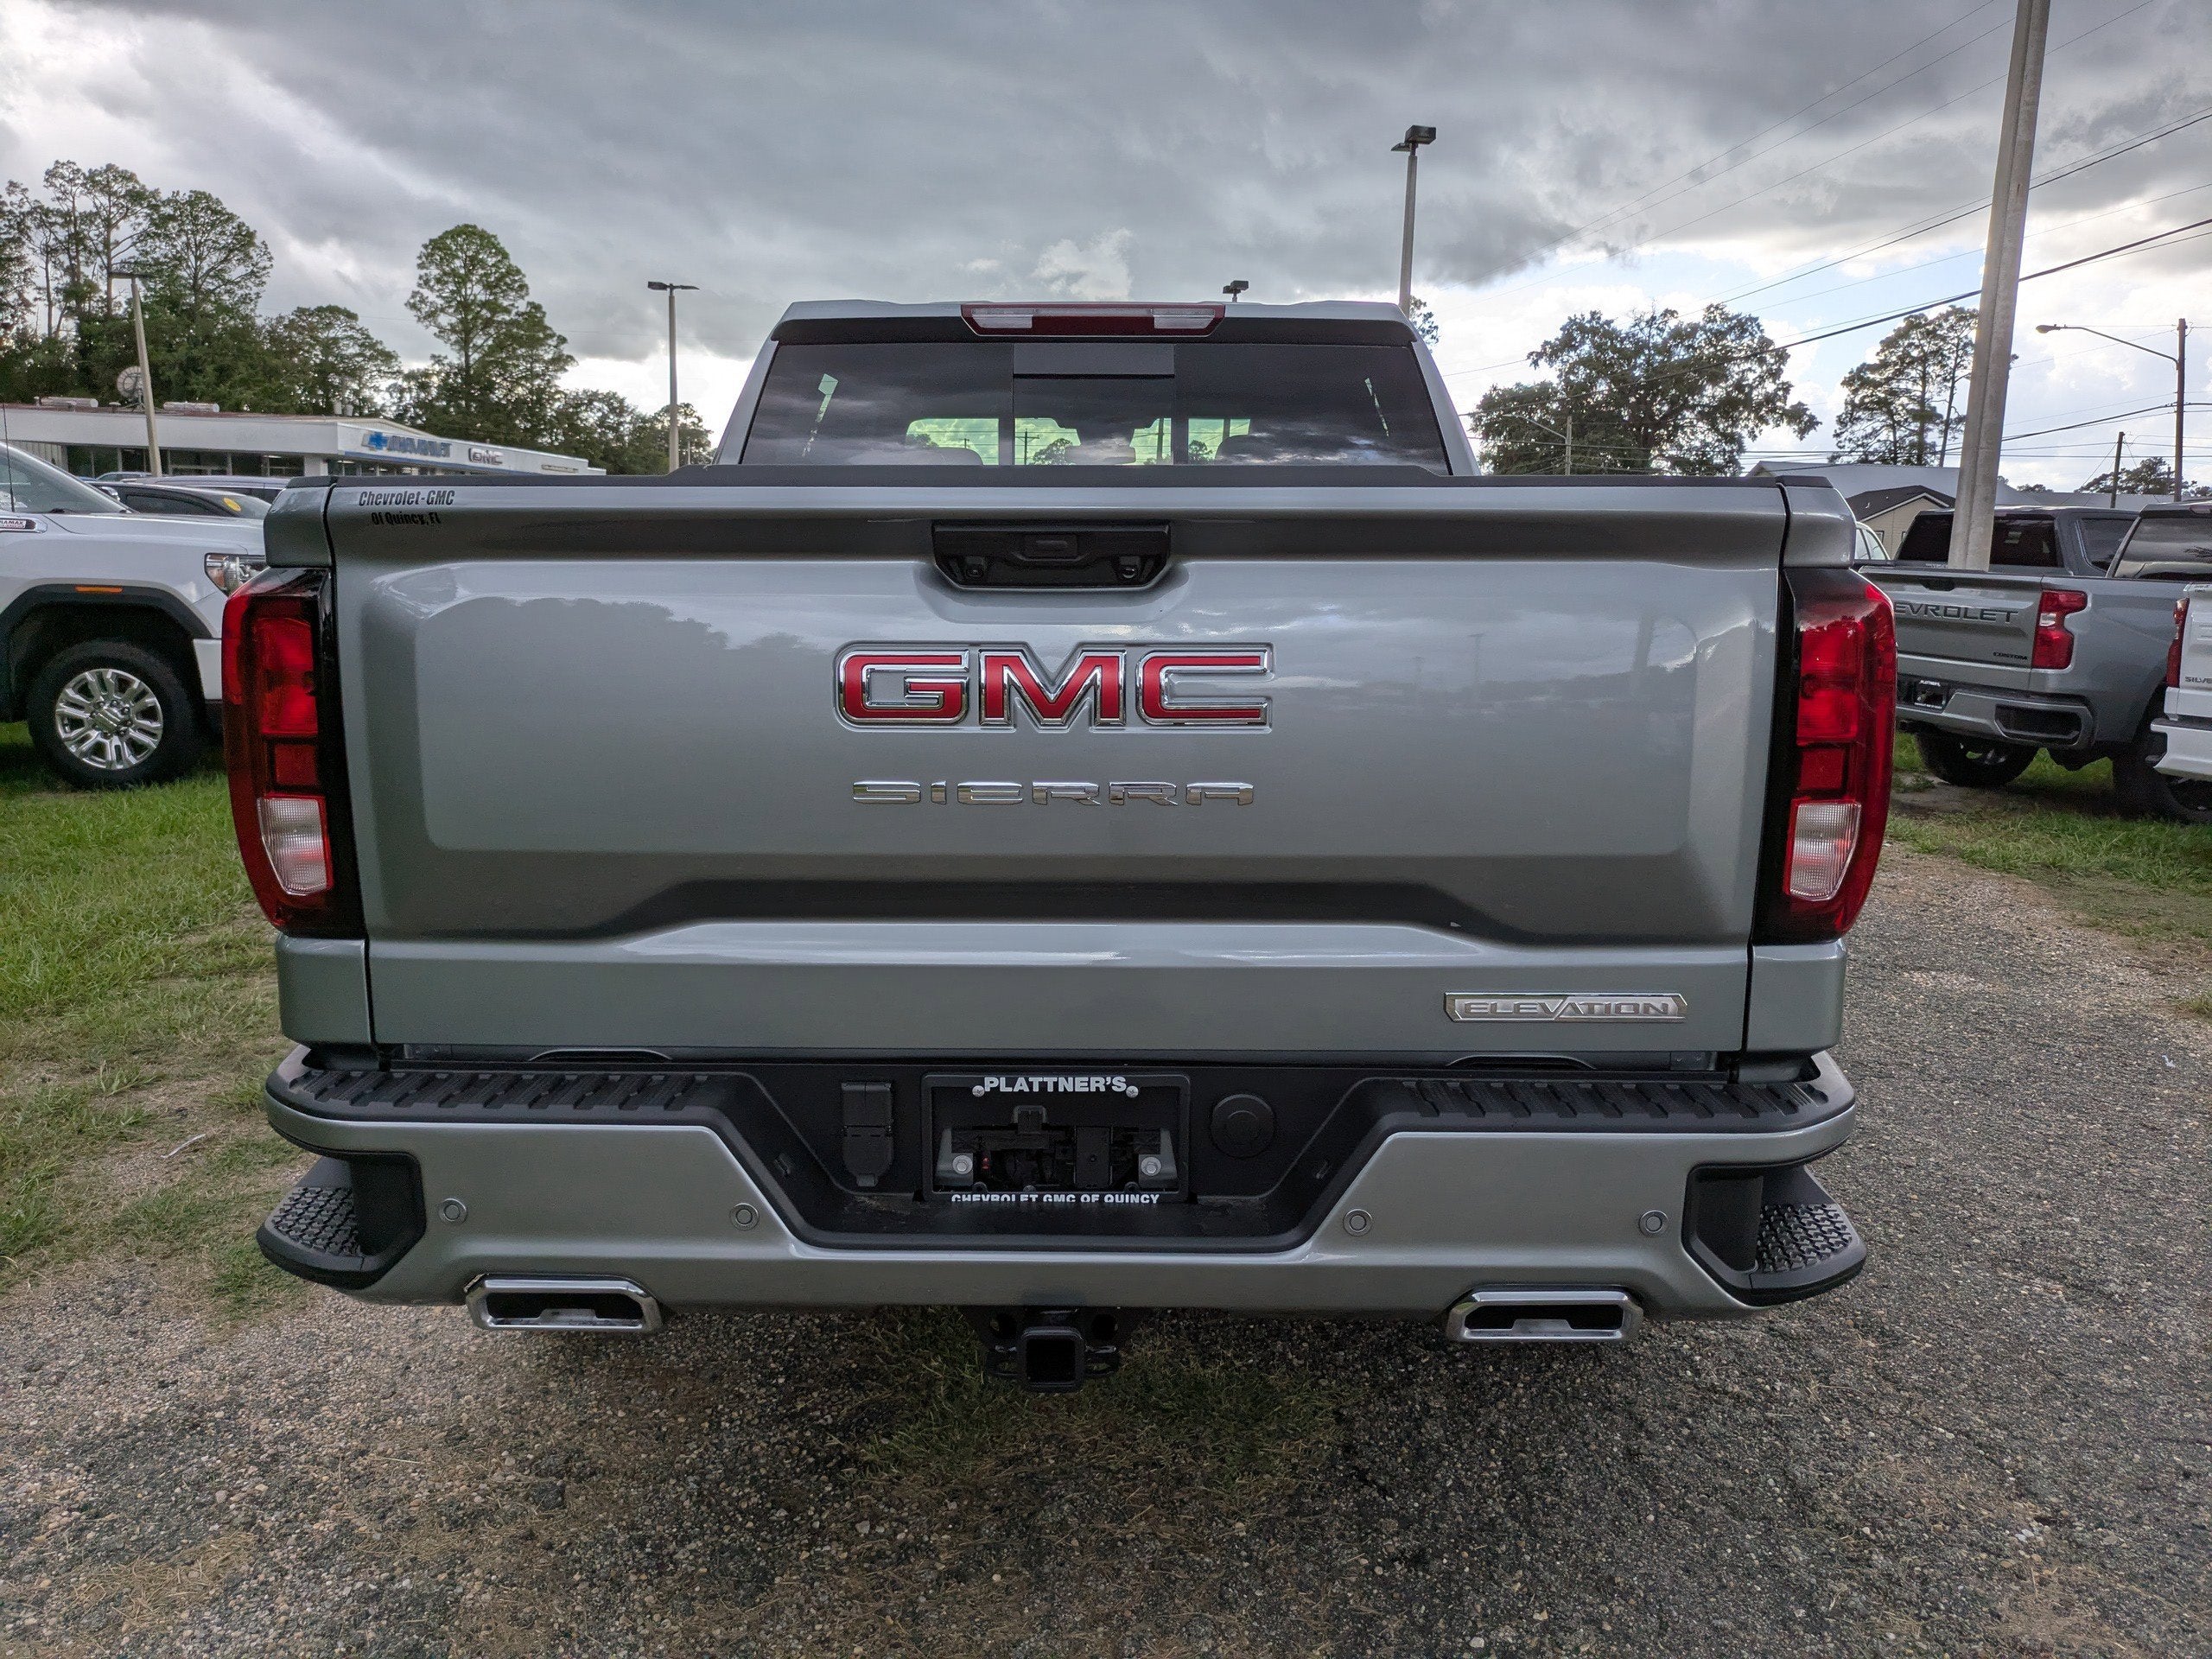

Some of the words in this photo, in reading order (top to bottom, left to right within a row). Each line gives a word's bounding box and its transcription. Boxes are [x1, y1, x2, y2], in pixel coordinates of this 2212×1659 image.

[359, 490, 455, 506] Chevrolet-GMC
[371, 512, 384, 525] Of
[838, 648, 1269, 726] GMC
[852, 781, 1255, 806] SIERRA
[1464, 1001, 1669, 1016] ELEVATION
[983, 1076, 1128, 1092] PLATTNER'S
[1103, 1194, 1160, 1204] QUINCY
